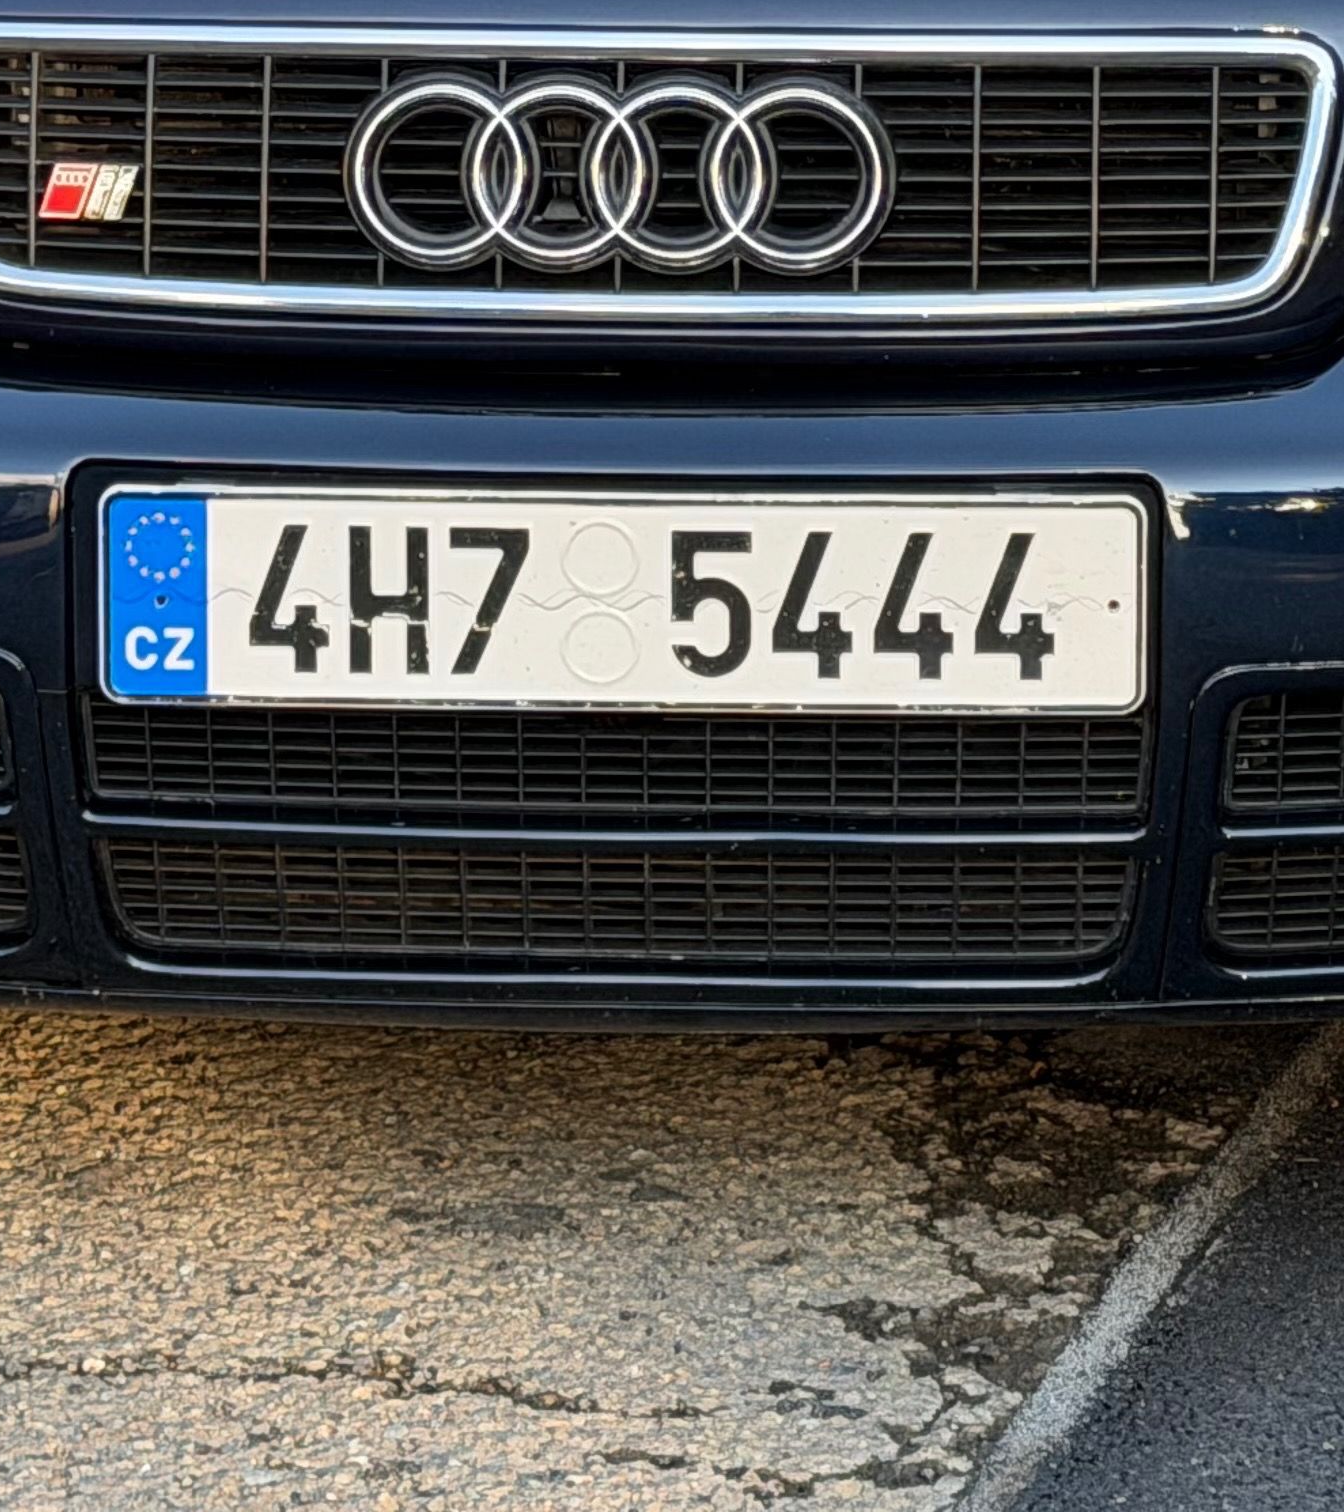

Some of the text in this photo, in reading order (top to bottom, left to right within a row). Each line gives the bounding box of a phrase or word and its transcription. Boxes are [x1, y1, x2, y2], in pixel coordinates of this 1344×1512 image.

[125, 626, 194, 670] CZ
[250, 526, 1054, 680] 4H7 5444
